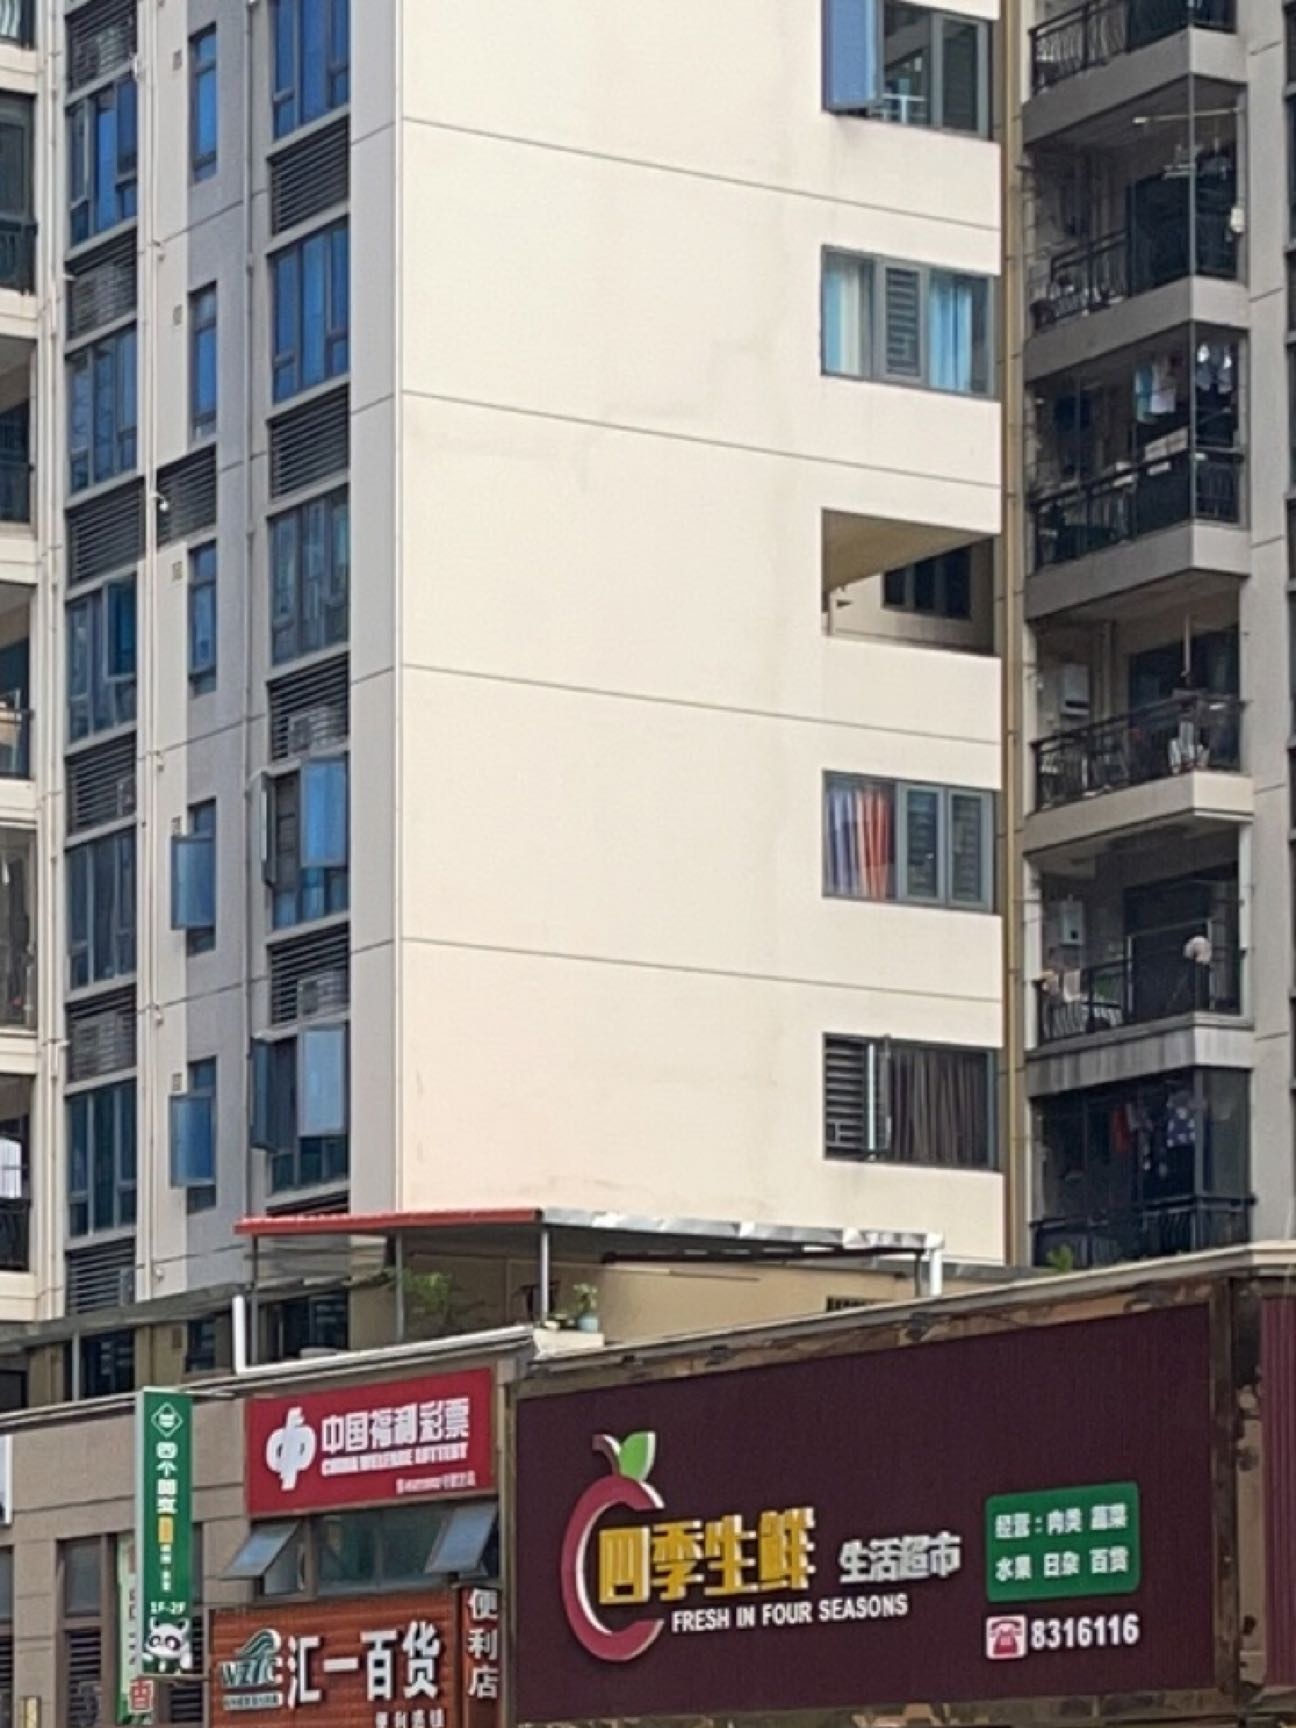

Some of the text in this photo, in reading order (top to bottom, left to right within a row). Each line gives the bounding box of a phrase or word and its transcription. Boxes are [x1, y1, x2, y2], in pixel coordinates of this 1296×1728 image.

[321, 1398, 470, 1454] 中国福利彩票
[599, 1507, 817, 1604] 四季生鲜
[838, 1531, 962, 1584] 生活超市
[995, 1554, 1032, 1582] 水果
[1089, 1545, 1129, 1574] 百货
[671, 1593, 909, 1633] FRESH IN FOUR SEASONS
[1031, 1613, 1140, 1650] 8316116
[288, 1621, 441, 1709] 汇一百货
[467, 1588, 500, 1698] 便利店
